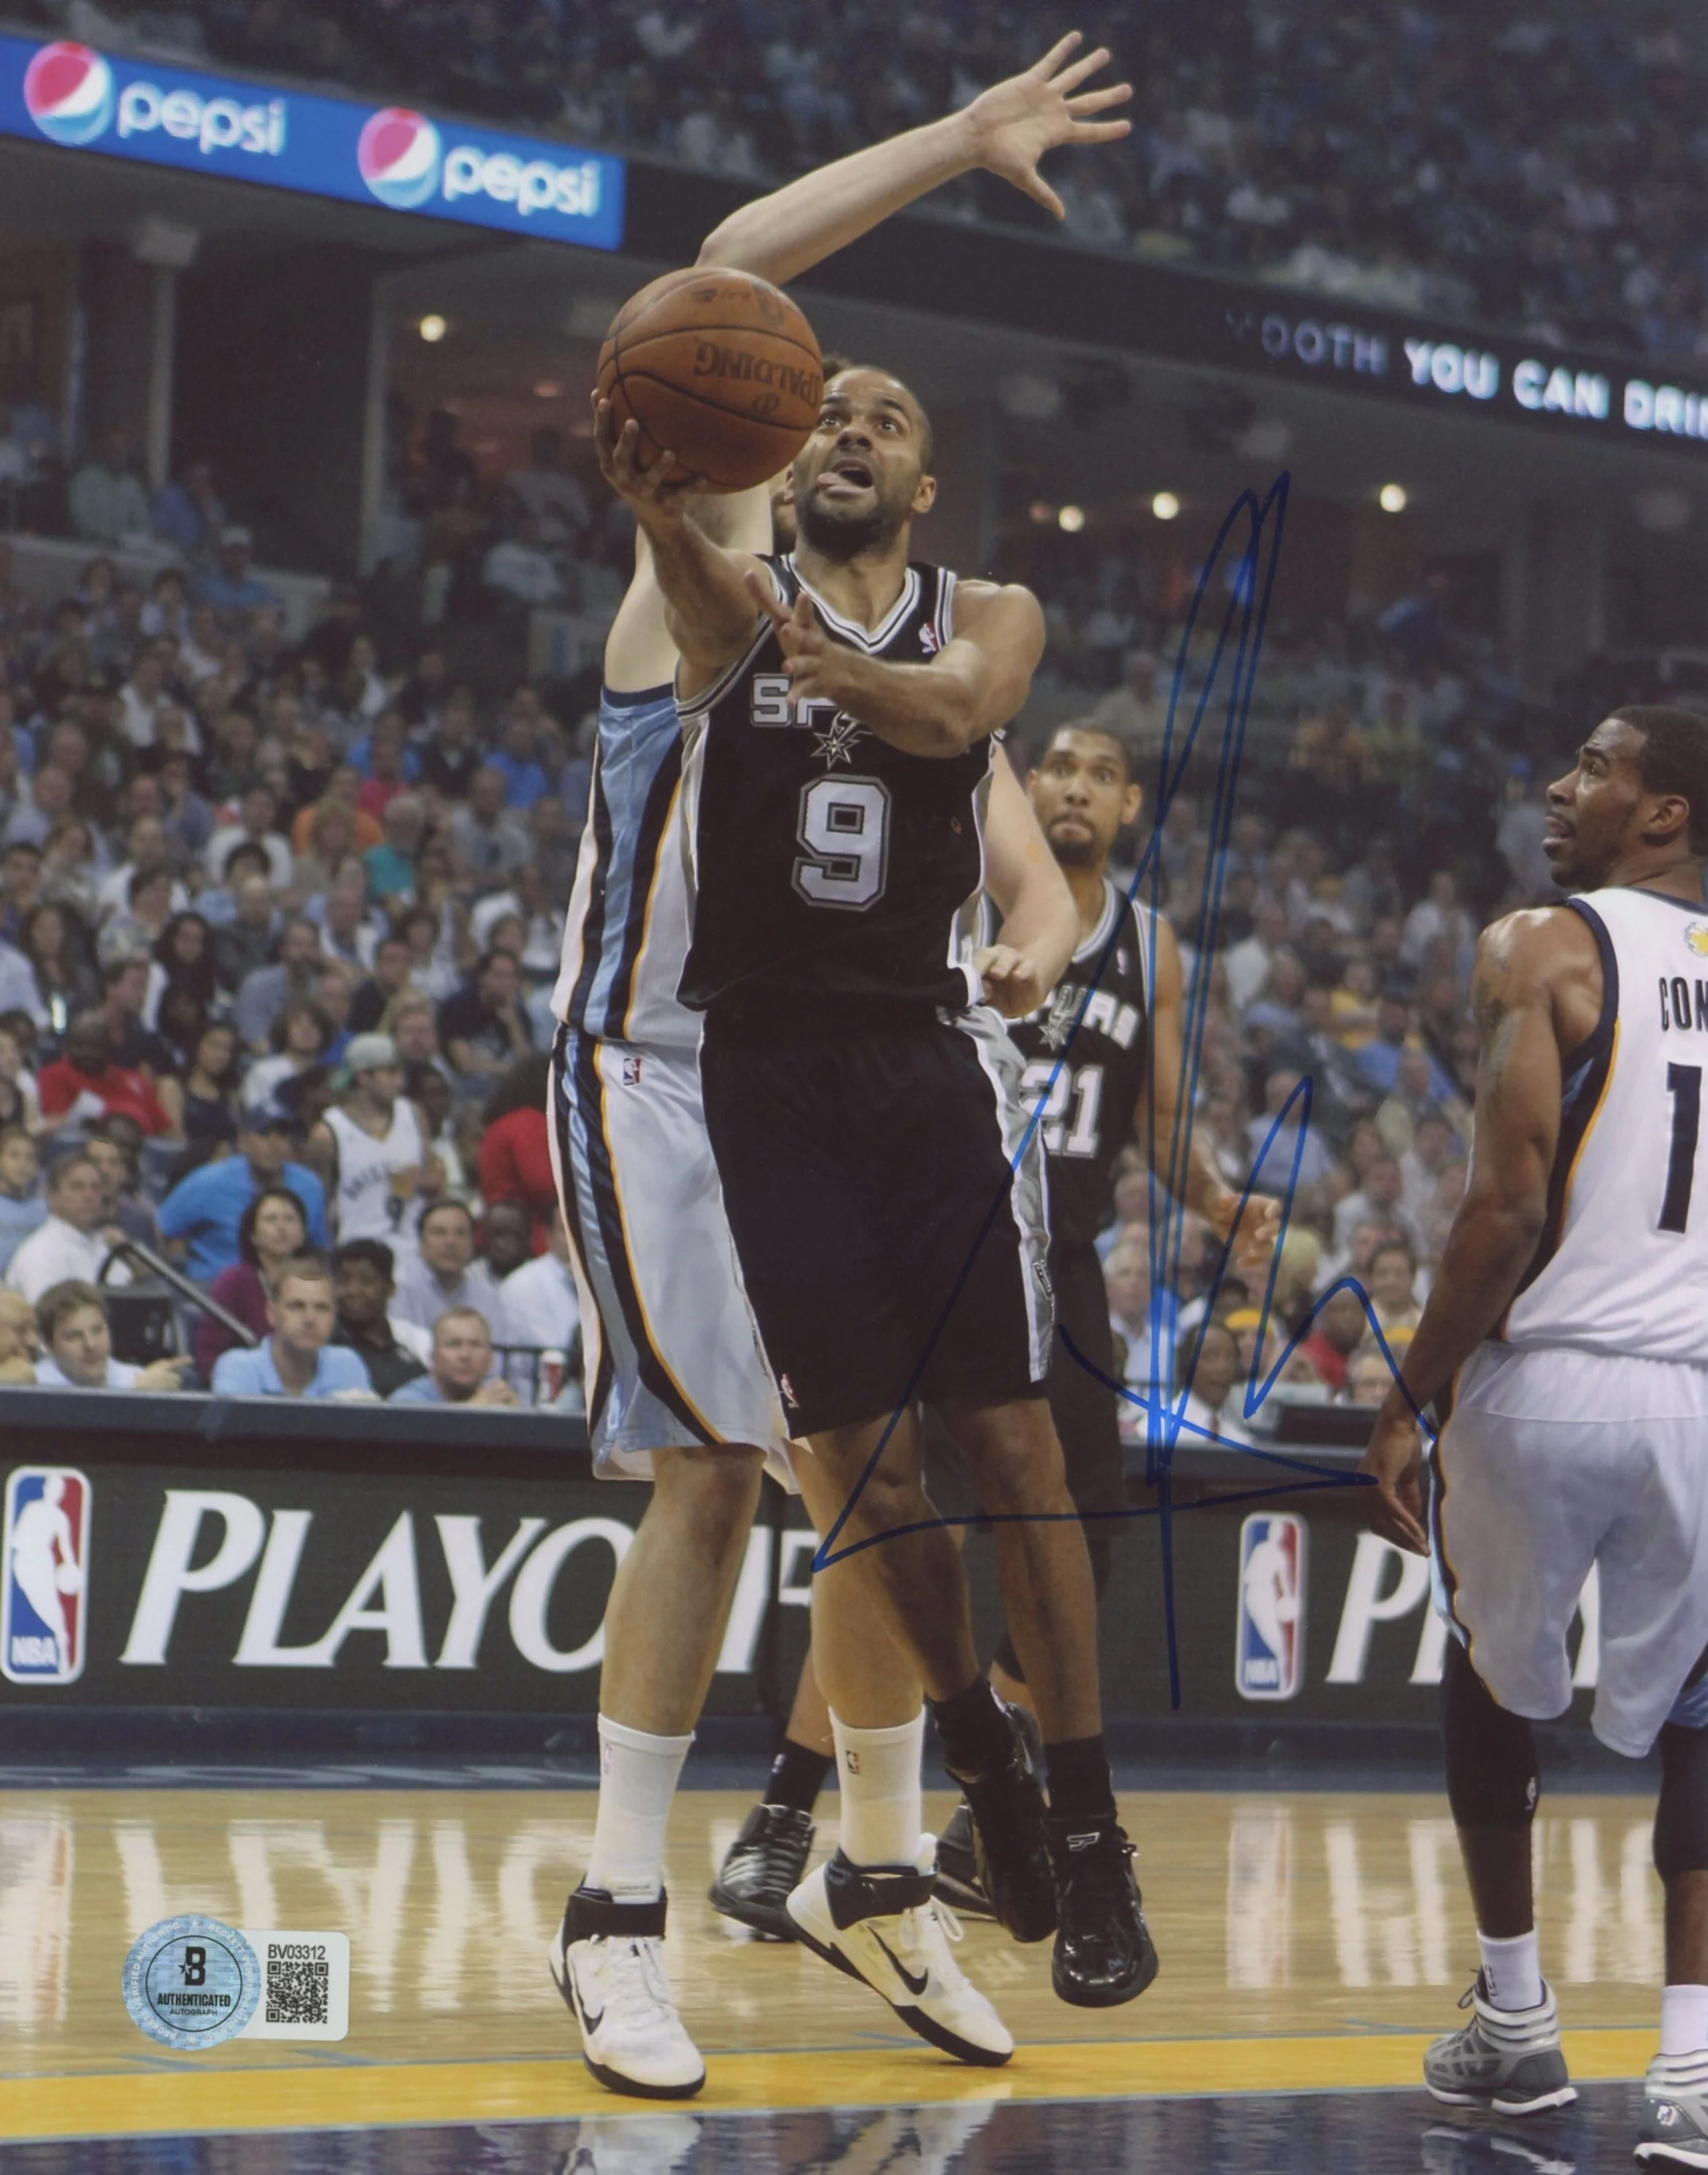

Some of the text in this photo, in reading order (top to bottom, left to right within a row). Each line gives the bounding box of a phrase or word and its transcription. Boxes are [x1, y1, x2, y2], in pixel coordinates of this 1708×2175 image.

[117, 80, 285, 156] pepsi
[443, 145, 601, 218] pepsi
[1403, 337, 1499, 399] YOU
[1512, 358, 1609, 419] CAN
[791, 772, 891, 912] 9
[1018, 1059, 1104, 1159] 21
[1657, 1061, 1701, 1234] 1
[11, 1635, 58, 1667] NBA
